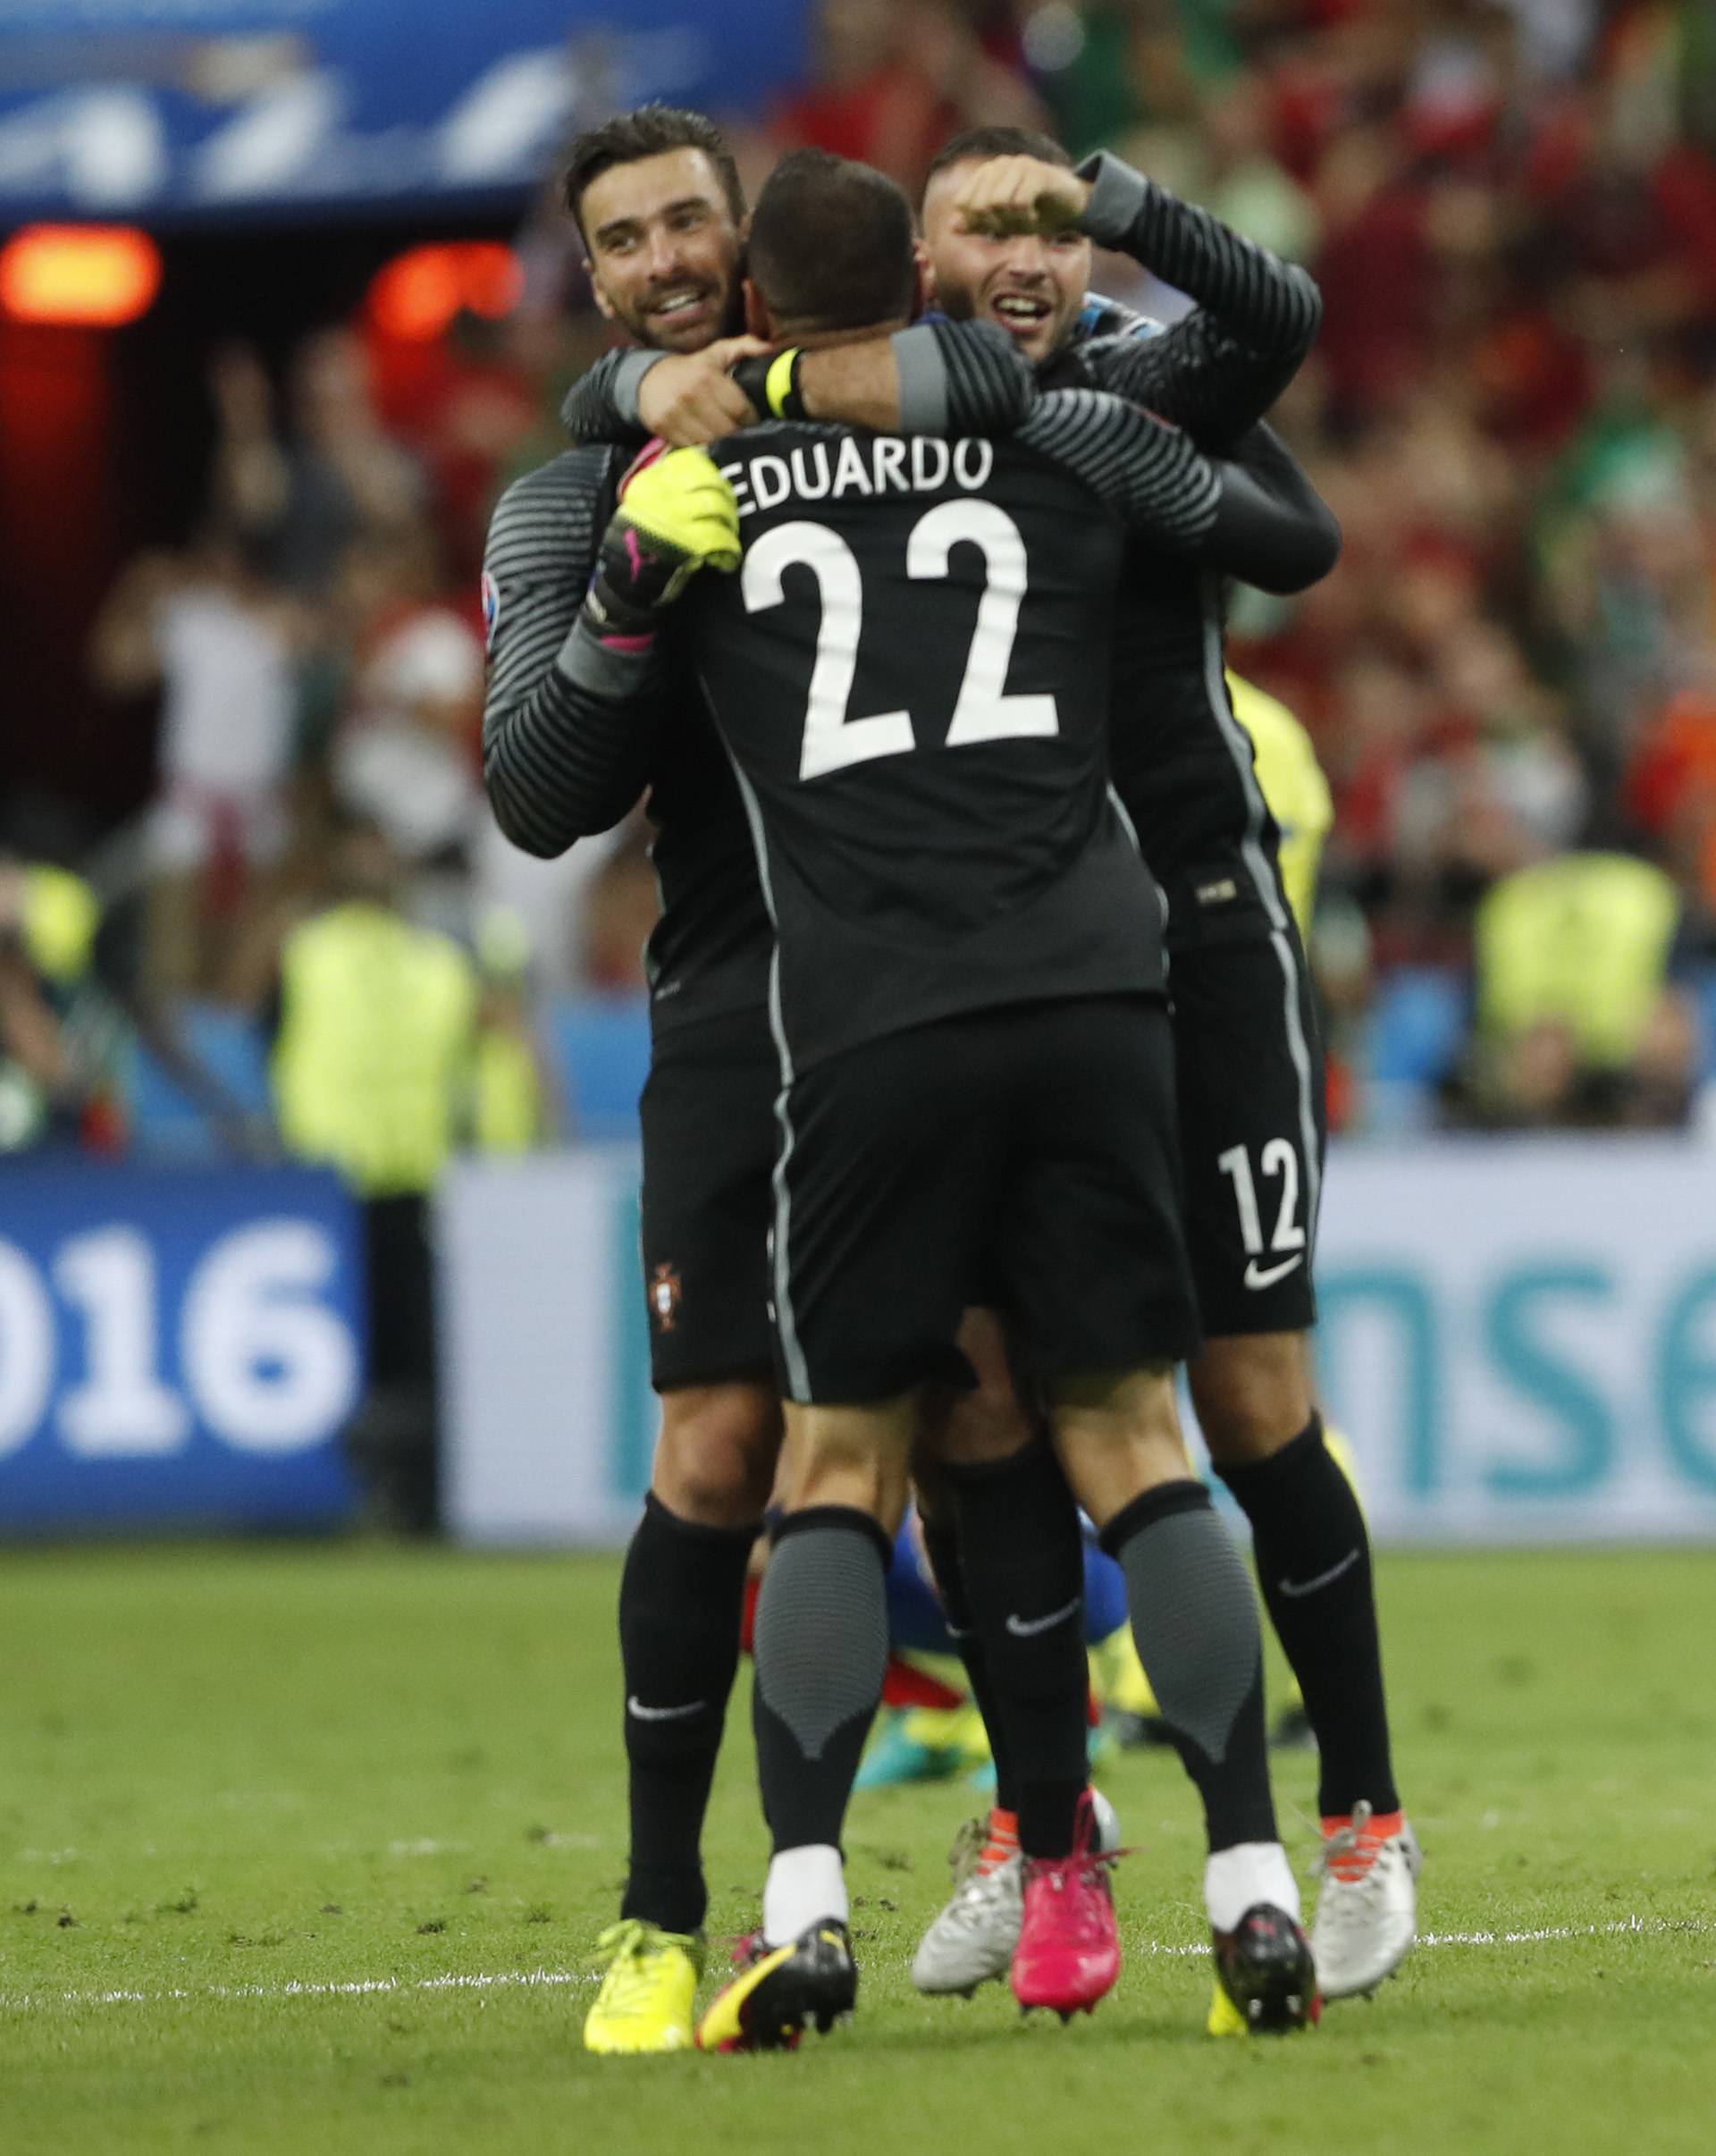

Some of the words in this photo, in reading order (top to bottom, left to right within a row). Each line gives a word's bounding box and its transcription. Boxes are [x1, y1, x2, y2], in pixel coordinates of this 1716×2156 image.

[719, 435, 993, 518] EDUARDO
[741, 497, 1060, 782] 22
[1216, 1137, 1306, 1255] 12
